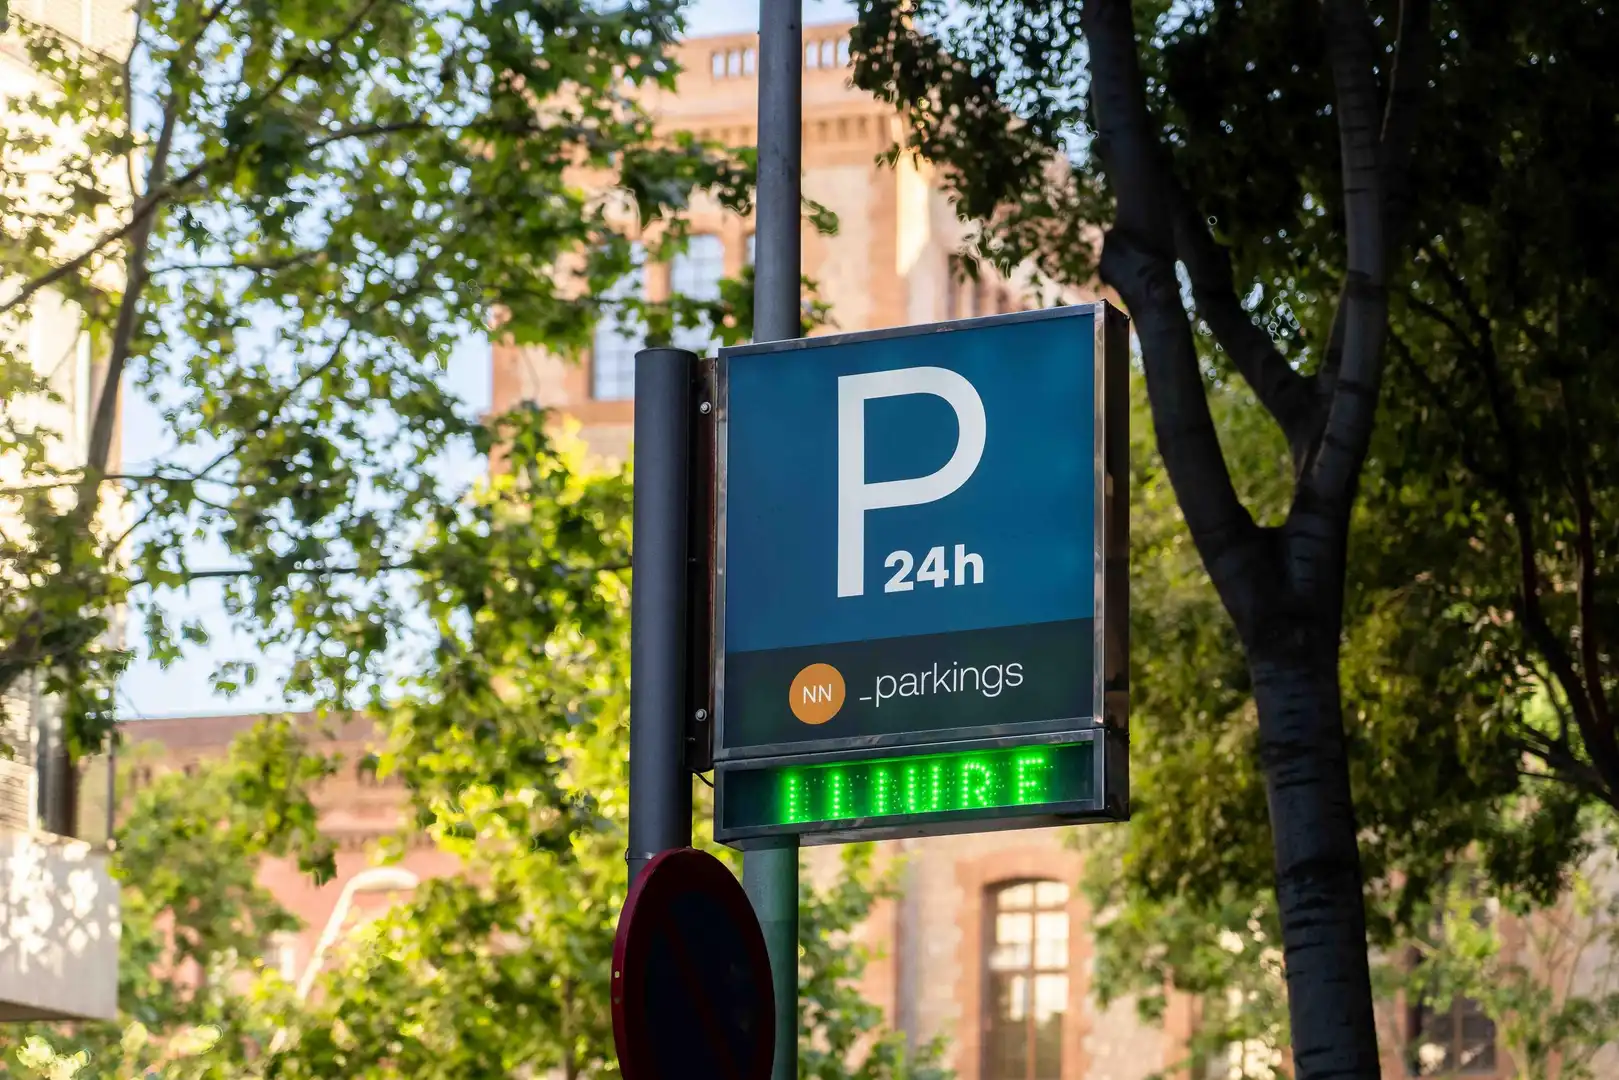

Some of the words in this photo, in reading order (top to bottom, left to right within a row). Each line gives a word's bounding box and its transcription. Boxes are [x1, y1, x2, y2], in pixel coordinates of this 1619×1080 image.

[837, 366, 987, 598] P
[884, 544, 985, 593] 24h
[803, 684, 833, 704] NN
